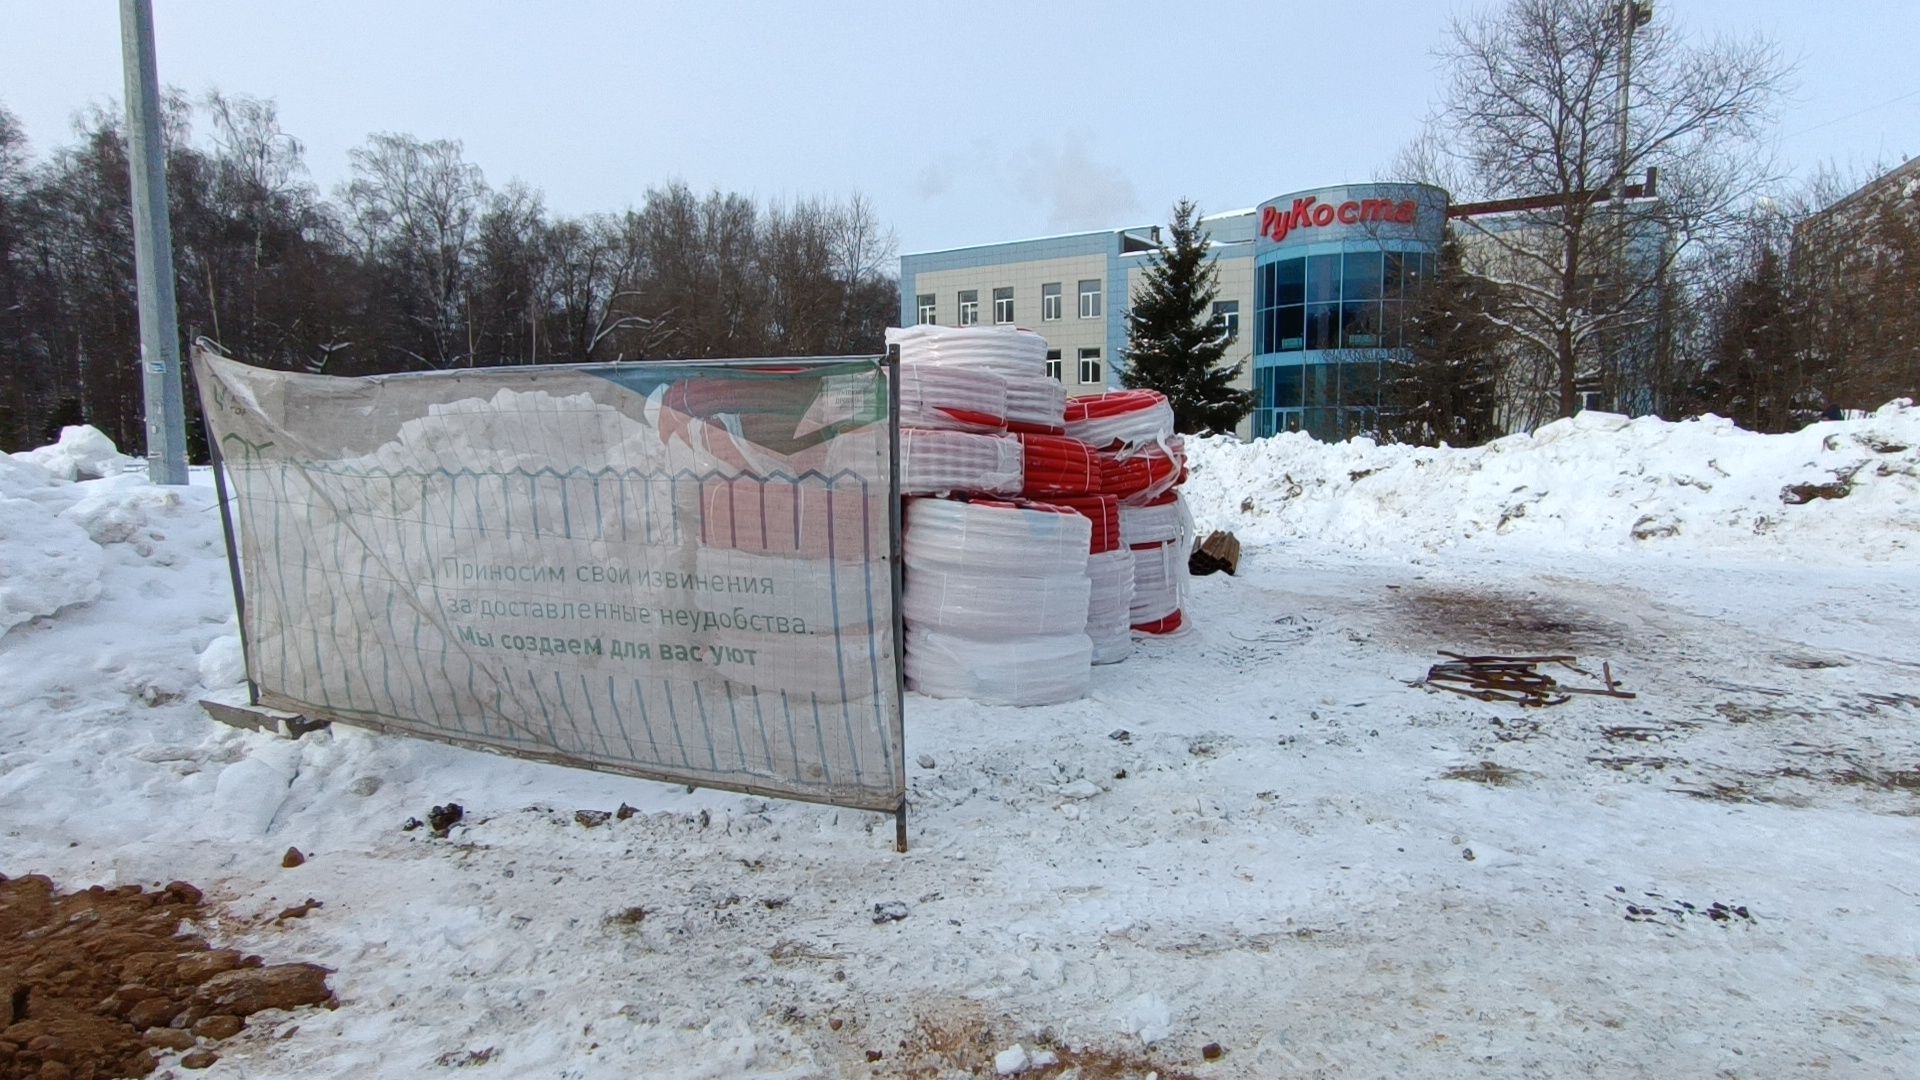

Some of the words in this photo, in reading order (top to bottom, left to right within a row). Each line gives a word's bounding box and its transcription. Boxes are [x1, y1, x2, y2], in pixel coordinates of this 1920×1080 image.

[1261, 197, 1416, 242] РуКоста
[441, 556, 566, 584] Приносим
[576, 565, 630, 584] свои
[638, 568, 774, 595] извинения
[447, 598, 472, 614] за
[480, 599, 651, 624] доставленные
[660, 607, 815, 635] неудобства.
[456, 624, 495, 648] Мы
[501, 634, 604, 656] создаем
[610, 638, 651, 660] для
[659, 643, 703, 662] вас
[709, 645, 758, 666] уют
